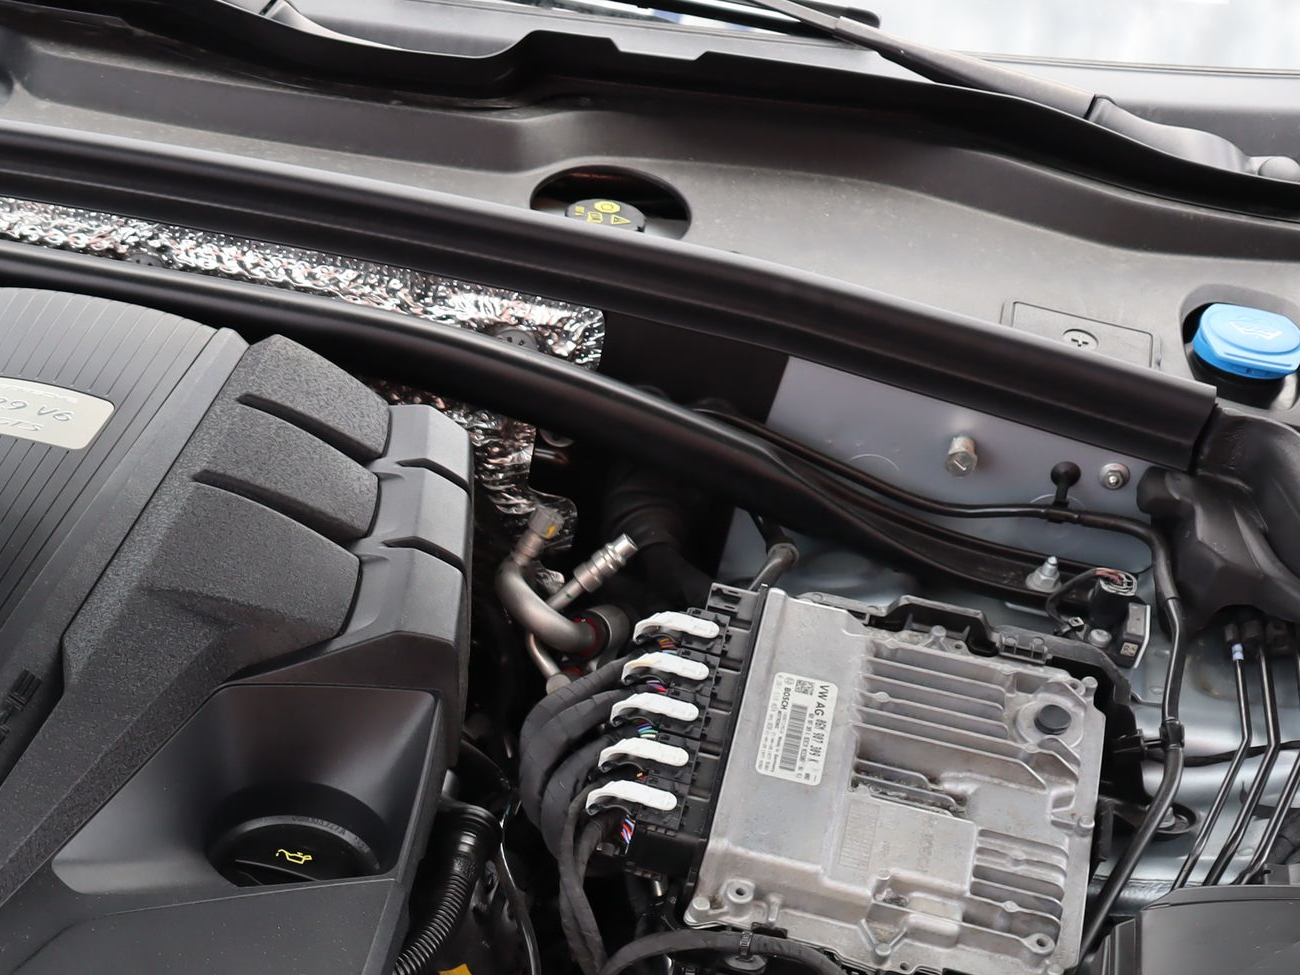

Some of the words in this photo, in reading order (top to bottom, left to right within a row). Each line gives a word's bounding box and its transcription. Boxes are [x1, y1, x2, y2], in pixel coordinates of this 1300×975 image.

[37, 405, 72, 422] V6
[780, 687, 791, 710] BOSCH
[817, 684, 829, 700] VW
[814, 701, 825, 716] AG
